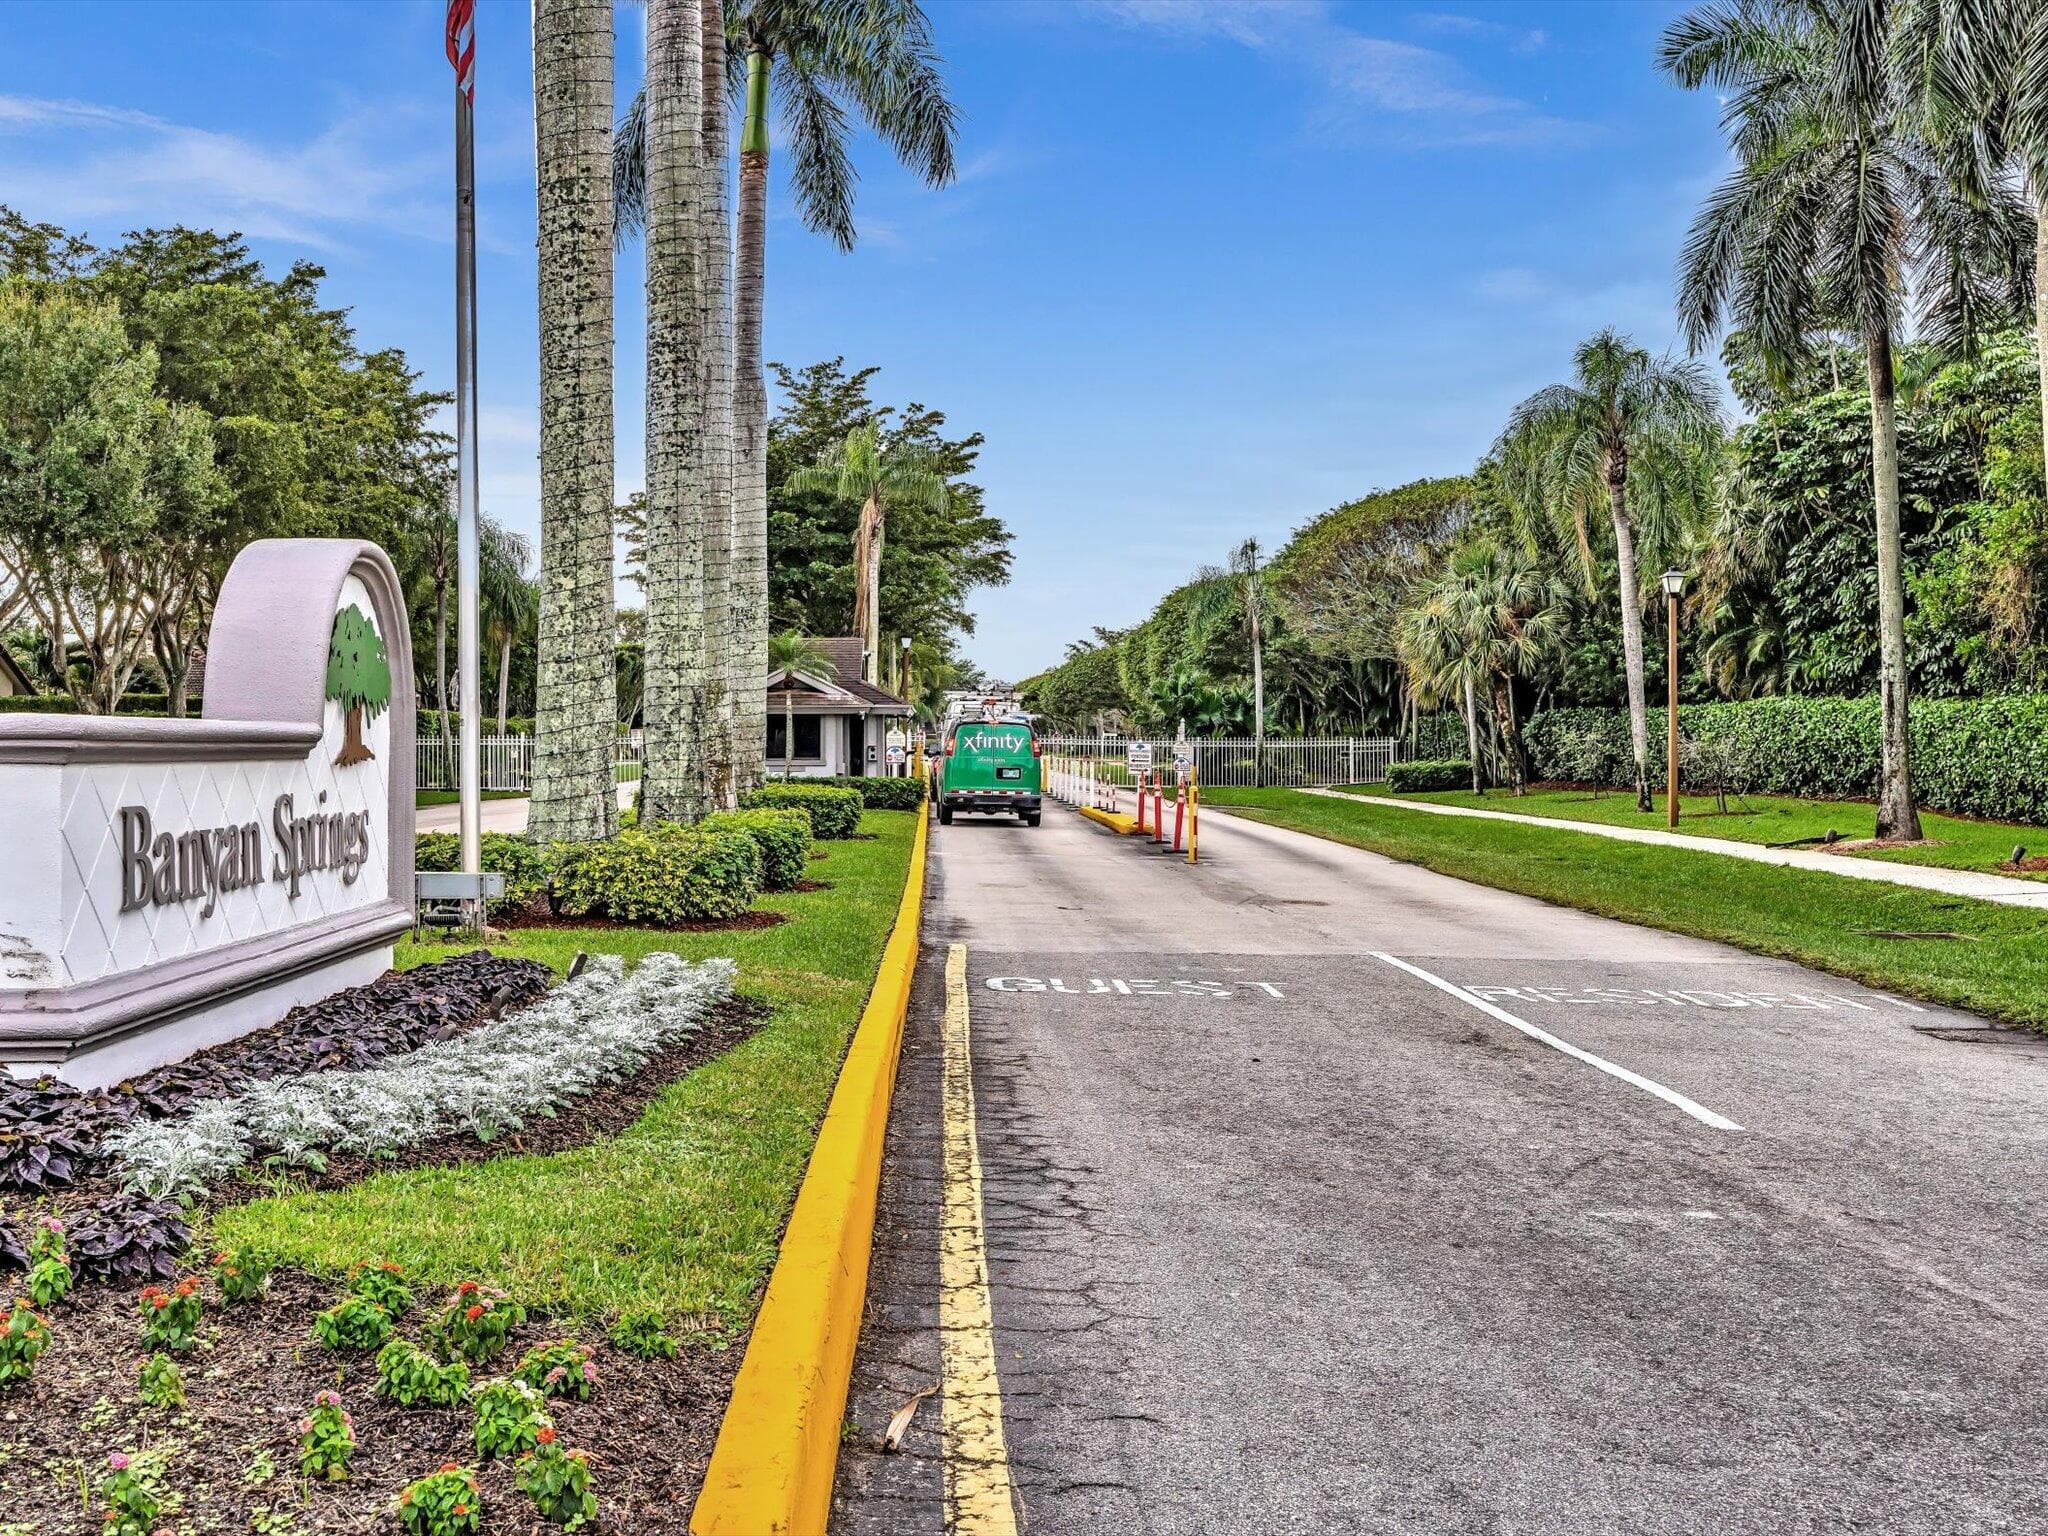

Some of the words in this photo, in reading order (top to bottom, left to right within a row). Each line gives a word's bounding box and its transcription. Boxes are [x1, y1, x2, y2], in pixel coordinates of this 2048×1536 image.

[963, 731, 1024, 753] xfinity
[121, 805, 264, 918] Banyan
[273, 789, 368, 898] Springs
[986, 977, 1288, 998] GUEST
[1463, 985, 1928, 1012] RESIDENT
